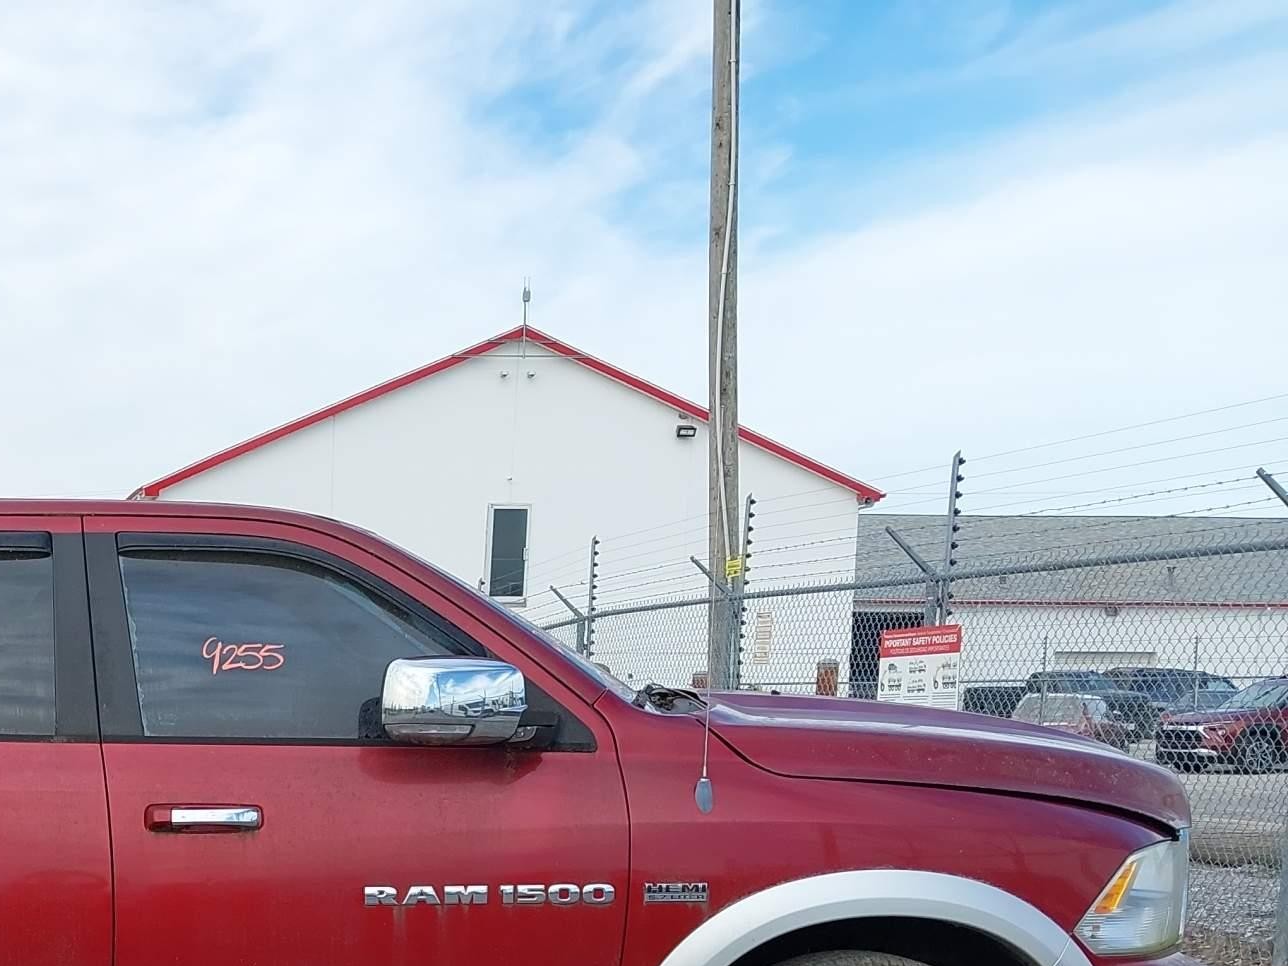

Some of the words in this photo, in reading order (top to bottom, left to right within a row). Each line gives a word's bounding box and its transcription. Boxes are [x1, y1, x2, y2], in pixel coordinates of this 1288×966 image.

[884, 639, 912, 649] IMPORTANT
[912, 637, 932, 647] SAFETY
[932, 634, 958, 645] POLICIES
[202, 636, 284, 675] 9255
[364, 884, 489, 905] RAM
[499, 883, 616, 905] 1500
[645, 882, 708, 893] HEMI
